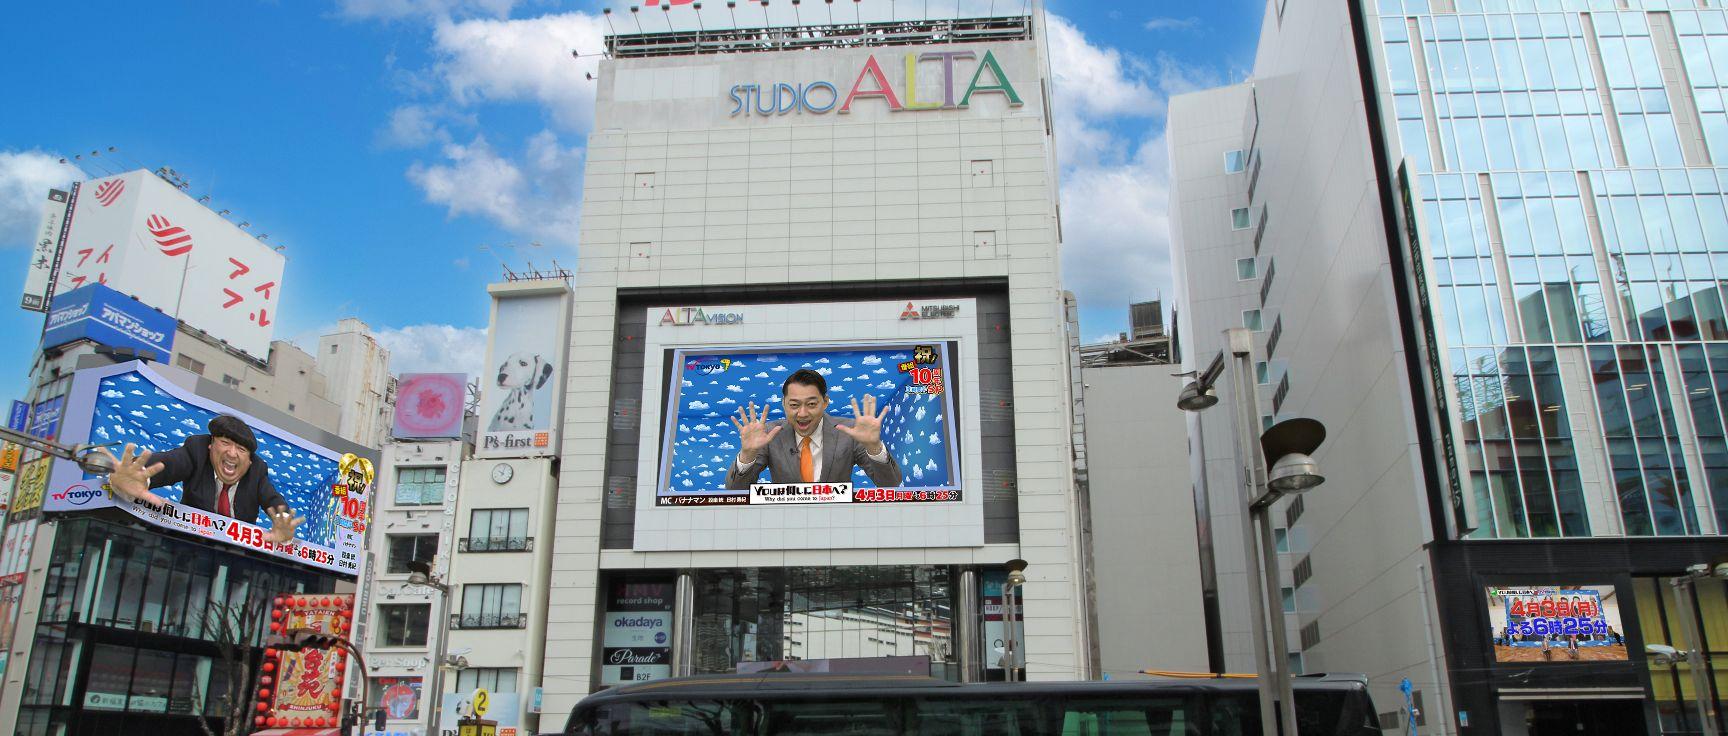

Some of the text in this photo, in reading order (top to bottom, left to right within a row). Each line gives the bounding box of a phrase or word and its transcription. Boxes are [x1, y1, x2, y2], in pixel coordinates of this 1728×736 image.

[730, 49, 1024, 116] STUDIO ALTA
[101, 307, 165, 343] アパマンショップ
[67, 490, 103, 499] TOKYO
[660, 496, 672, 505] MC
[616, 596, 663, 606] record shop
[614, 616, 663, 630] okadaya
[1506, 616, 1608, 636] よる6時25分
[610, 649, 656, 664] Parade
[477, 691, 486, 712] 2
